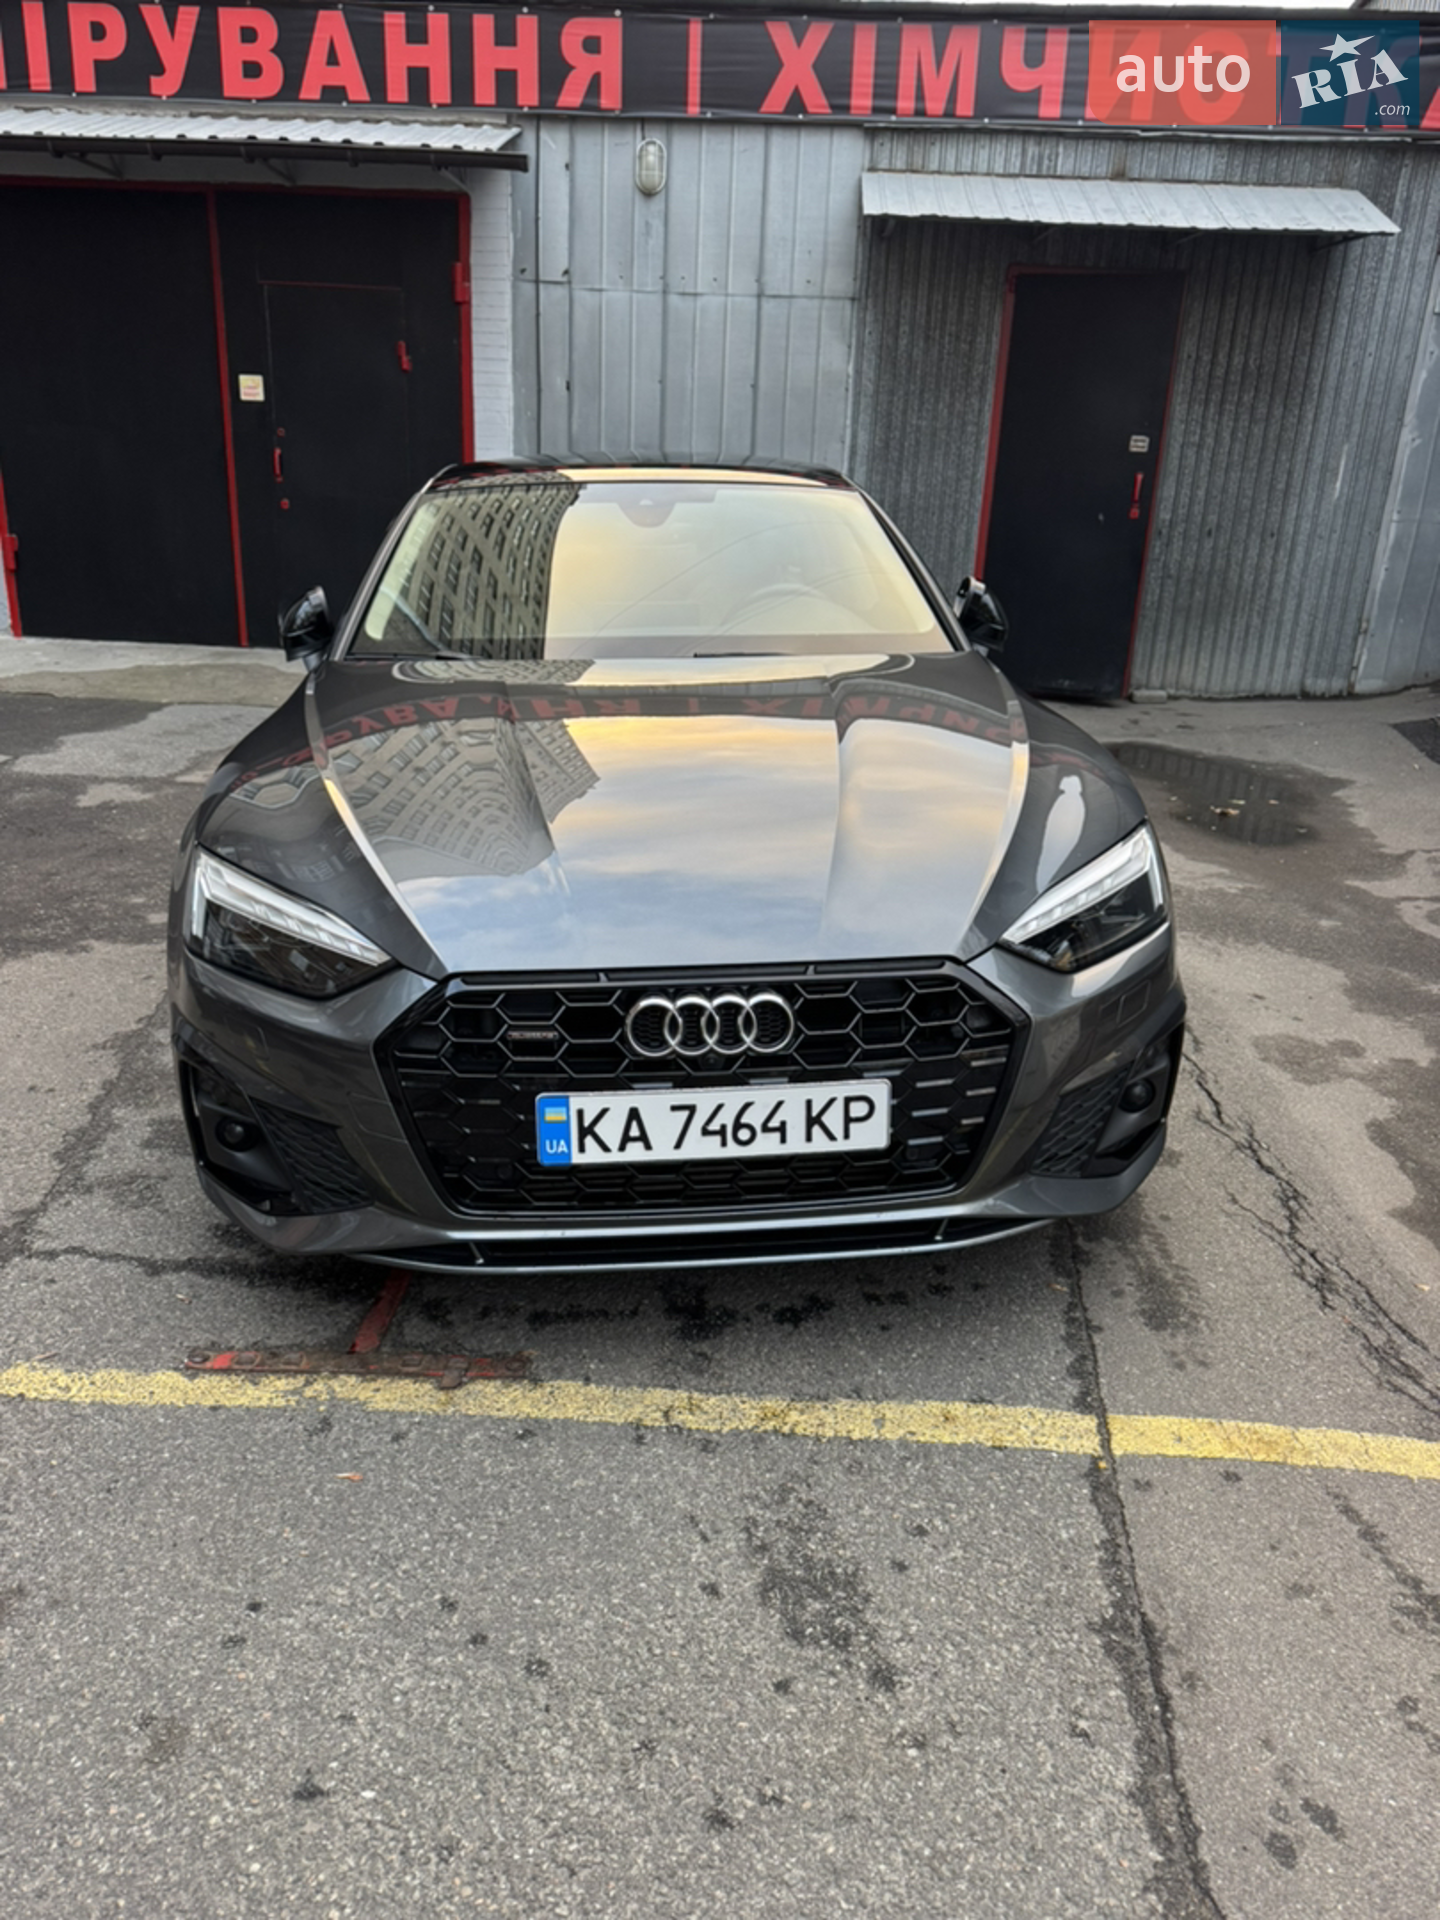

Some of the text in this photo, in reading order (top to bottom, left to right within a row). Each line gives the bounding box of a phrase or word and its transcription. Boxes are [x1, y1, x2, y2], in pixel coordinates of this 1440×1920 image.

[0, 0, 623, 110] ІРУВАННЯ
[545, 1139, 569, 1154] UA
[576, 1095, 875, 1154] KA 7464 KP
